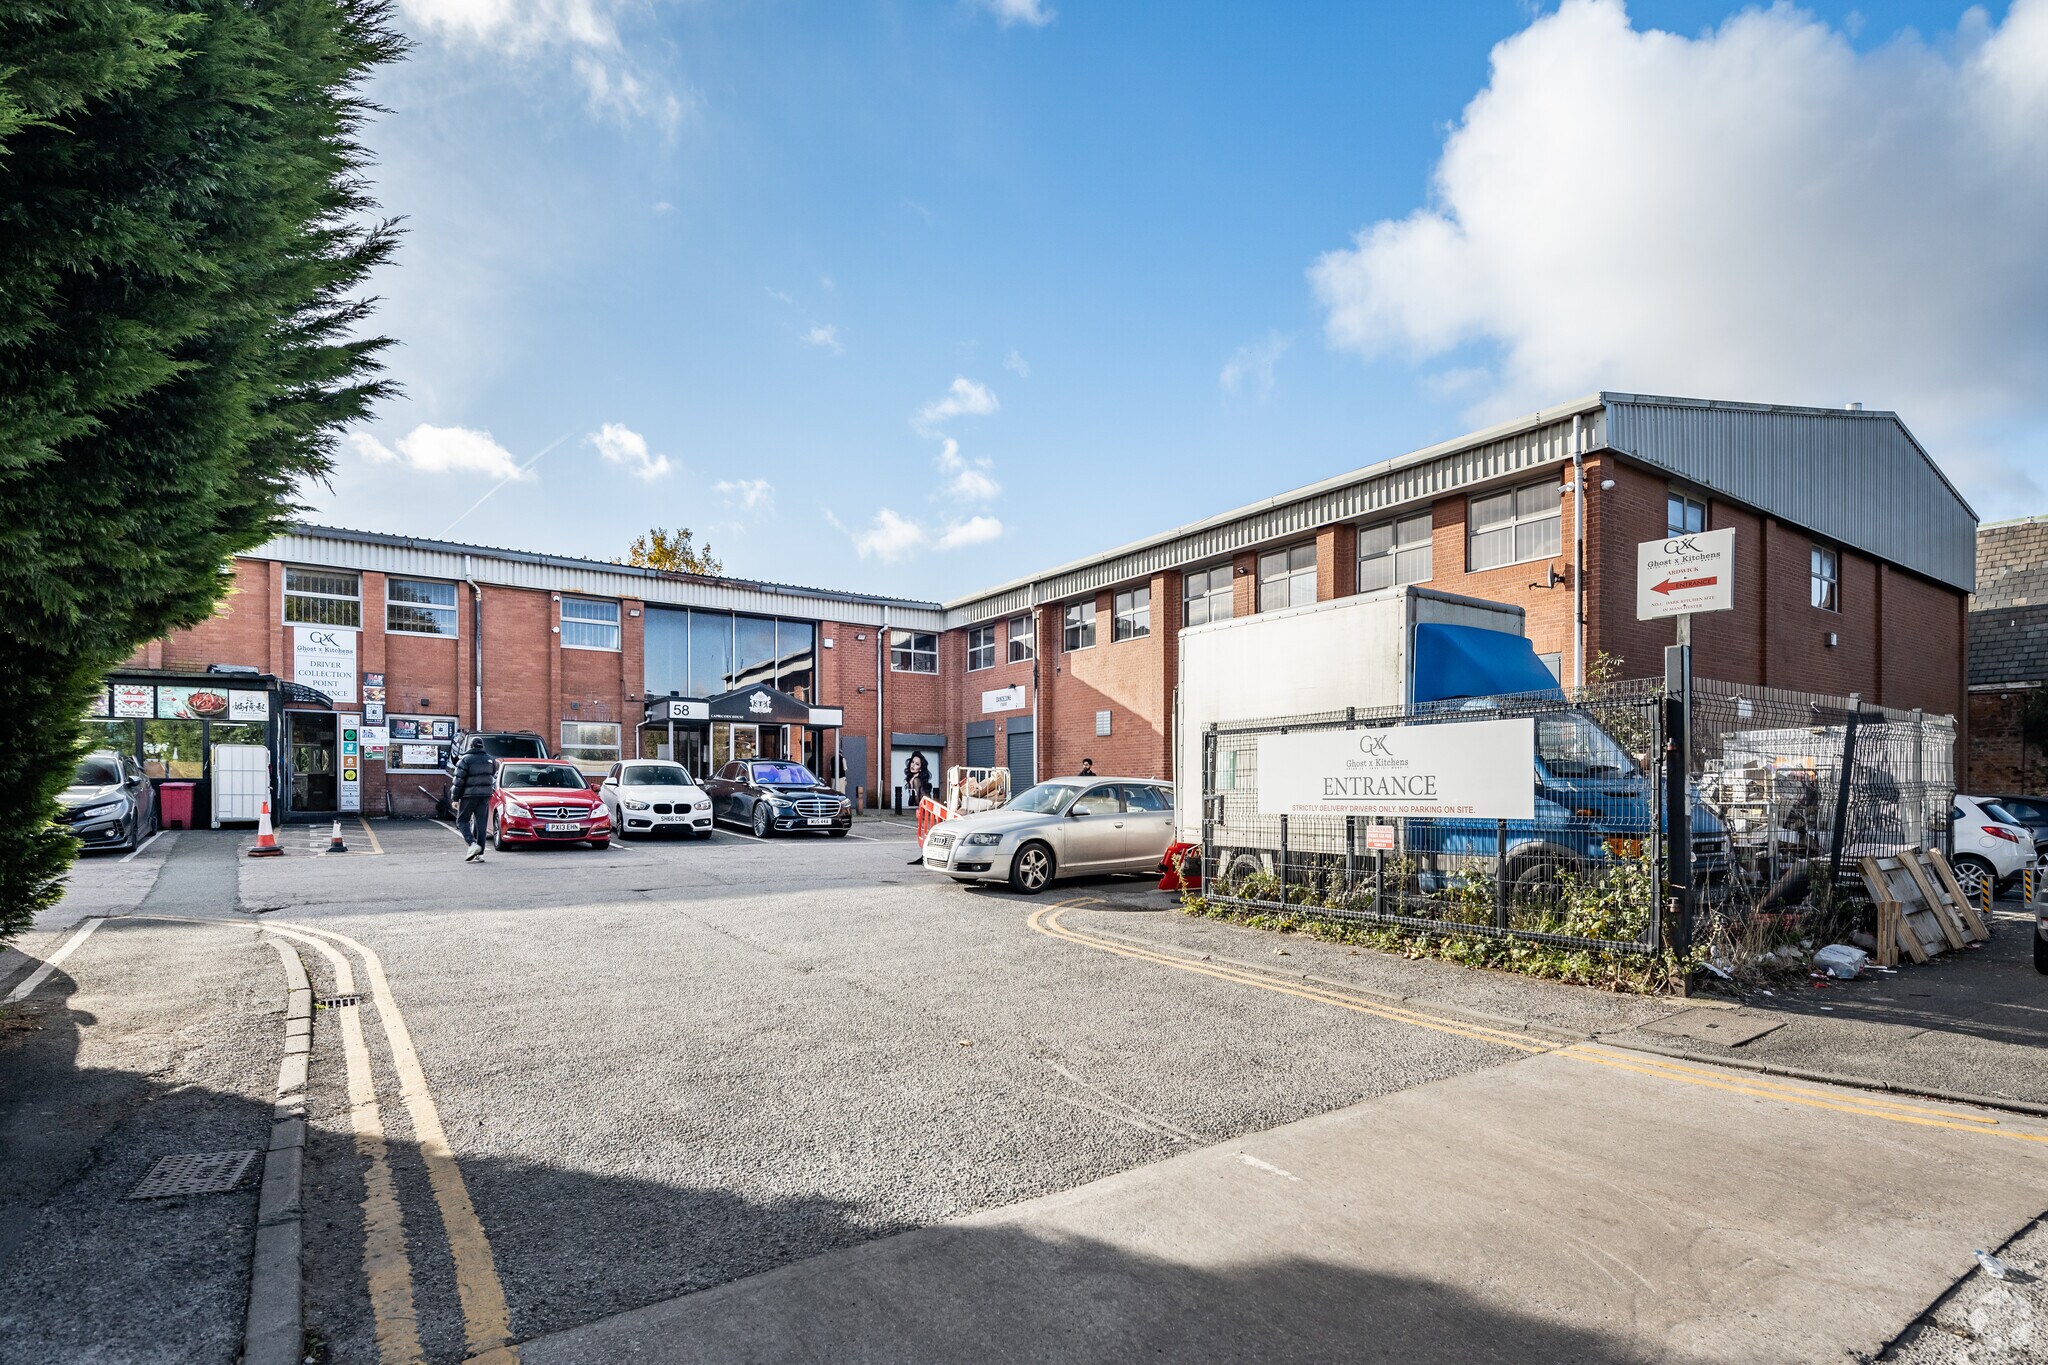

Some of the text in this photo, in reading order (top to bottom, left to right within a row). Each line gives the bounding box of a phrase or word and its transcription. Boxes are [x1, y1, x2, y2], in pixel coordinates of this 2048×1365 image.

[1647, 559, 1672, 568] Ghost
[1682, 551, 1721, 563] Kitchens
[1667, 566, 1699, 576] ARDWICK
[1675, 578, 1712, 589] ENTRANCE
[325, 646, 354, 654] Kitchens
[310, 660, 341, 669] DRIVER
[298, 669, 352, 678] COLLECTION
[673, 704, 690, 716] 58
[1346, 759, 1367, 768] Ghost
[1375, 758, 1409, 767] Kitchens
[1323, 775, 1437, 796] ENTRANCE
[1292, 804, 1318, 812] STRICTLY
[1319, 804, 1348, 812] DELIVERY
[1350, 804, 1377, 813] DRIVERS
[1410, 805, 1442, 814] PARKING
[1444, 806, 1455, 814] ON
[1456, 805, 1476, 814] SITE.
